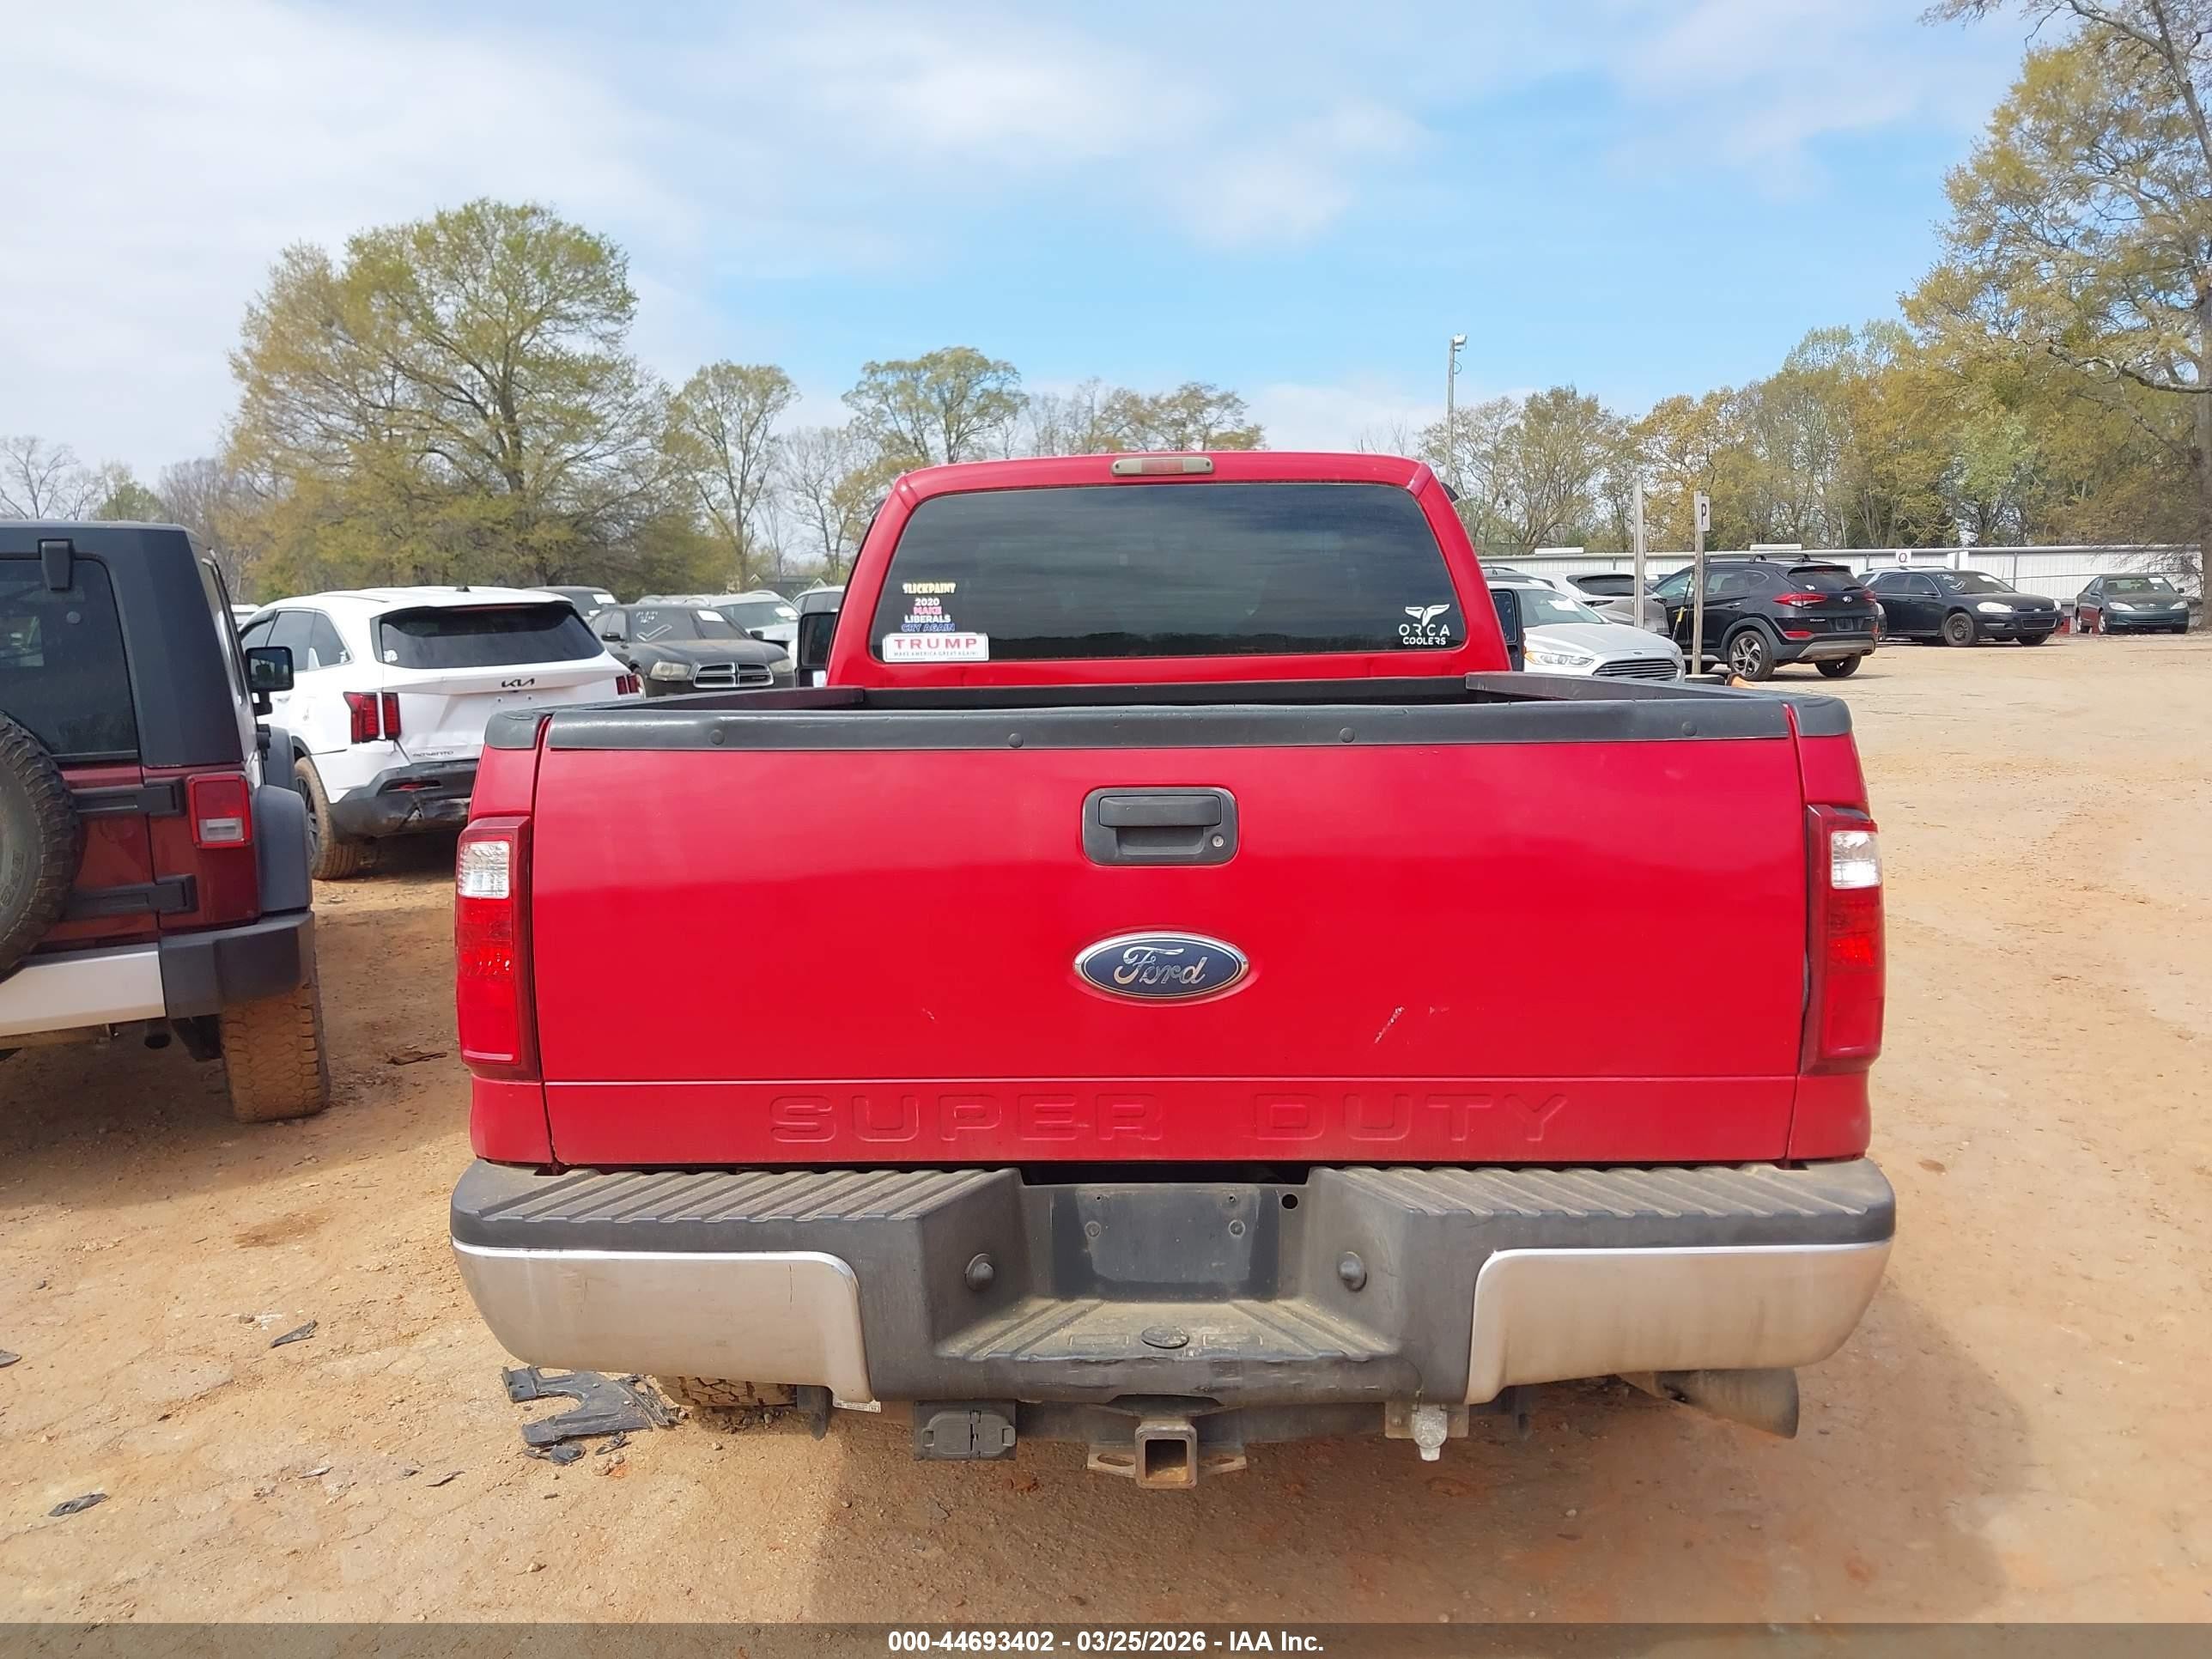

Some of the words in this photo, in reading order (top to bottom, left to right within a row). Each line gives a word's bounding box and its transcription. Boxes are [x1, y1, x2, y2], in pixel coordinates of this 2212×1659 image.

[1701, 503, 1707, 526] P
[915, 598, 940, 606] 2020
[914, 606, 942, 615] MAKE
[904, 615, 951, 623] LIBERALS
[923, 623, 955, 632] AGAIN
[1398, 623, 1450, 636] ORCA
[894, 638, 977, 650] TRUMP
[1402, 636, 1446, 645] COOLERS
[1114, 945, 1208, 985] Ford
[769, 1094, 1164, 1143] SUPER
[1253, 1093, 1568, 1141] DUTY
